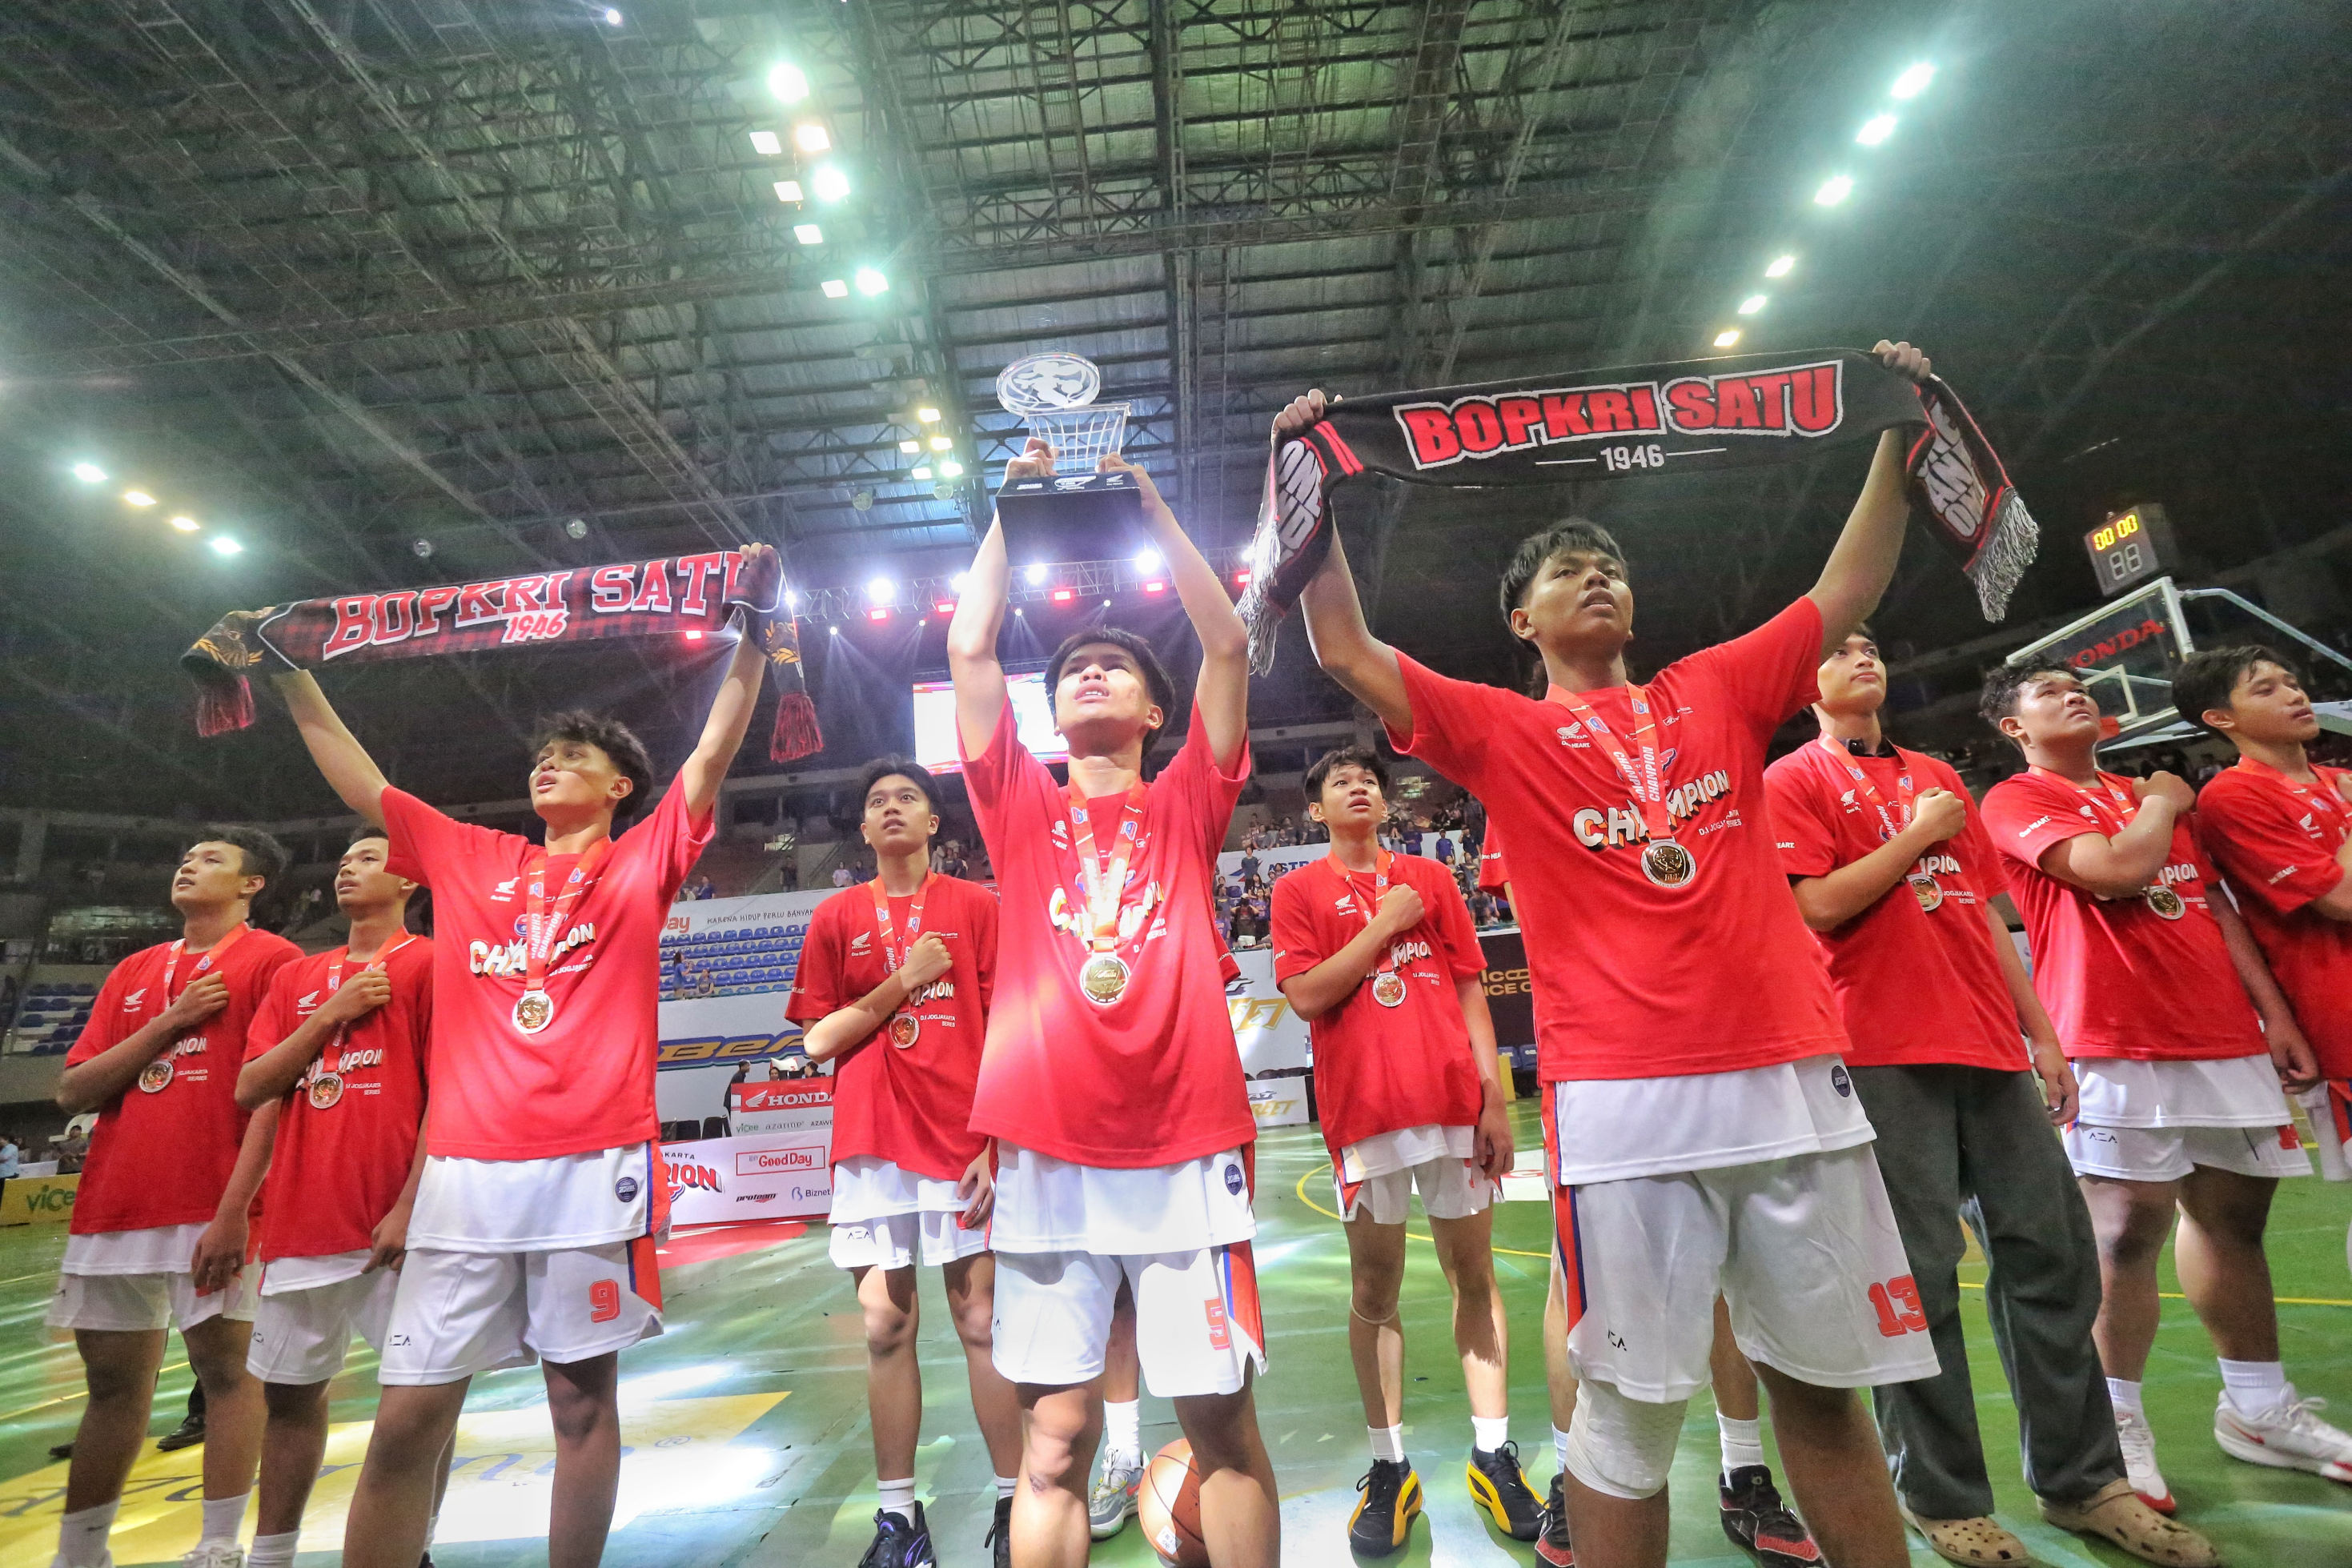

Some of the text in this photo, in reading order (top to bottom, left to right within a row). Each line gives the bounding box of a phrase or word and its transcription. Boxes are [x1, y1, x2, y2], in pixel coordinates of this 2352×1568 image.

[1392, 359, 1844, 471] BOPKRI SATU
[1599, 444, 1665, 472] 1946
[322, 570, 569, 661] BOPKRI
[504, 611, 569, 643] 1946
[2065, 619, 2165, 669] ONDA
[1642, 745, 1660, 803] CHAMPION
[1776, 841, 1796, 849] EART.
[1919, 855, 1961, 876] PION
[2158, 863, 2199, 885] PION
[666, 916, 690, 934] ay
[707, 909, 814, 924] KARENA HIDUP PERLU BANYAK
[537, 911, 562, 960] CHAMPION
[908, 981, 955, 1006] MPION
[172, 1037, 207, 1061] PION
[662, 1151, 696, 1160] KARTA
[736, 1188, 831, 1202] proteam Biznet
[589, 1278, 620, 1324] 9
[1866, 1273, 1929, 1338] 13
